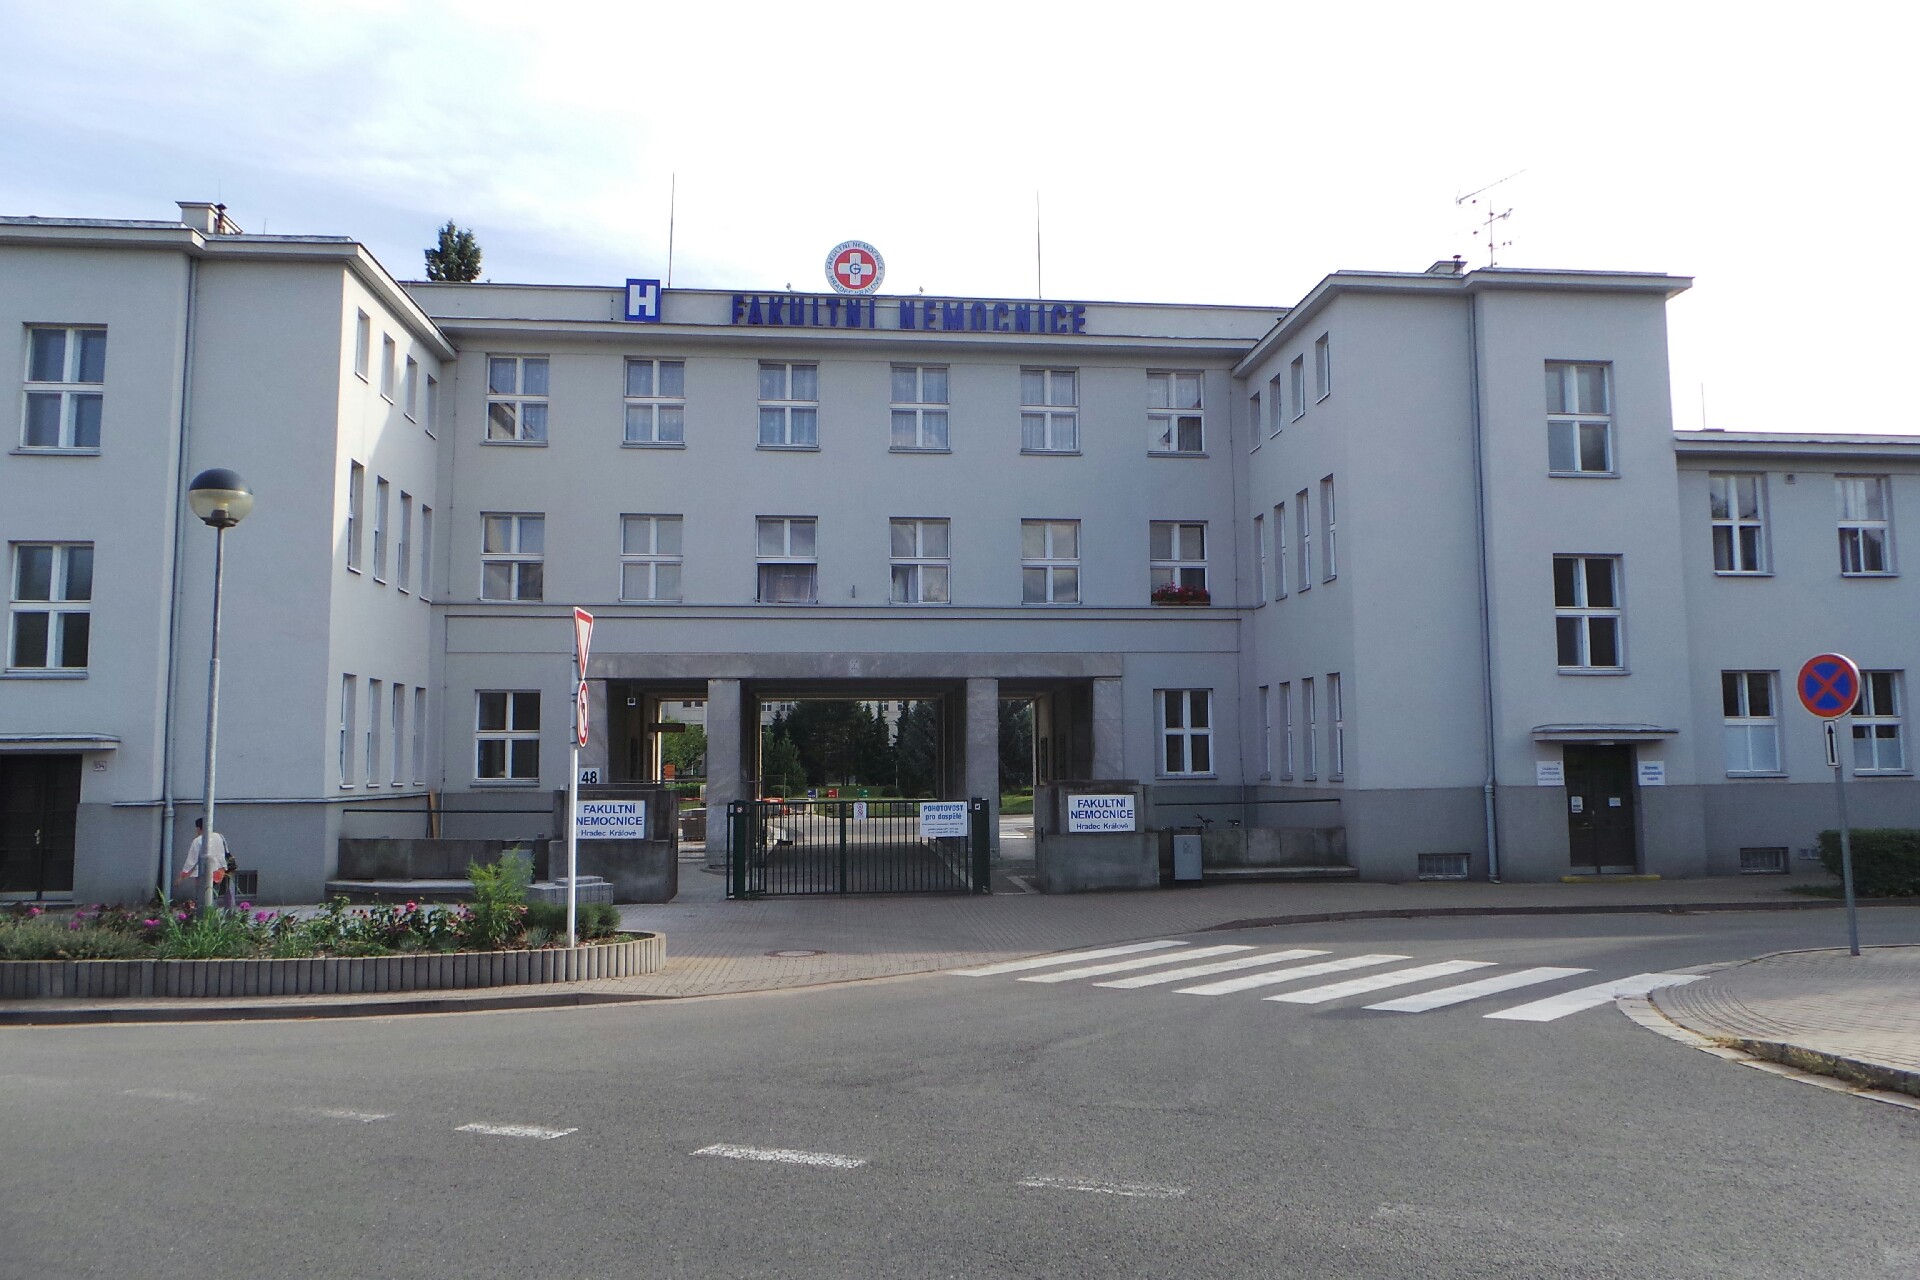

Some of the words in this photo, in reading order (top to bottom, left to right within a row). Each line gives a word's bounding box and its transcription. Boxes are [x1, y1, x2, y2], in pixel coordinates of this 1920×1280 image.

[629, 284, 656, 316] H
[900, 300, 1086, 334] NEMOCNICE
[581, 771, 597, 784] 48
[1077, 797, 1126, 808] FAKULTNÍ
[584, 803, 636, 814] FAKULTNÍ
[923, 804, 964, 812] POHOTOVOST
[938, 812, 961, 821] dospělé
[1070, 809, 1134, 819] NEMOCNICE
[576, 816, 642, 826] NEMOCNICE
[1103, 822, 1129, 830] Králové
